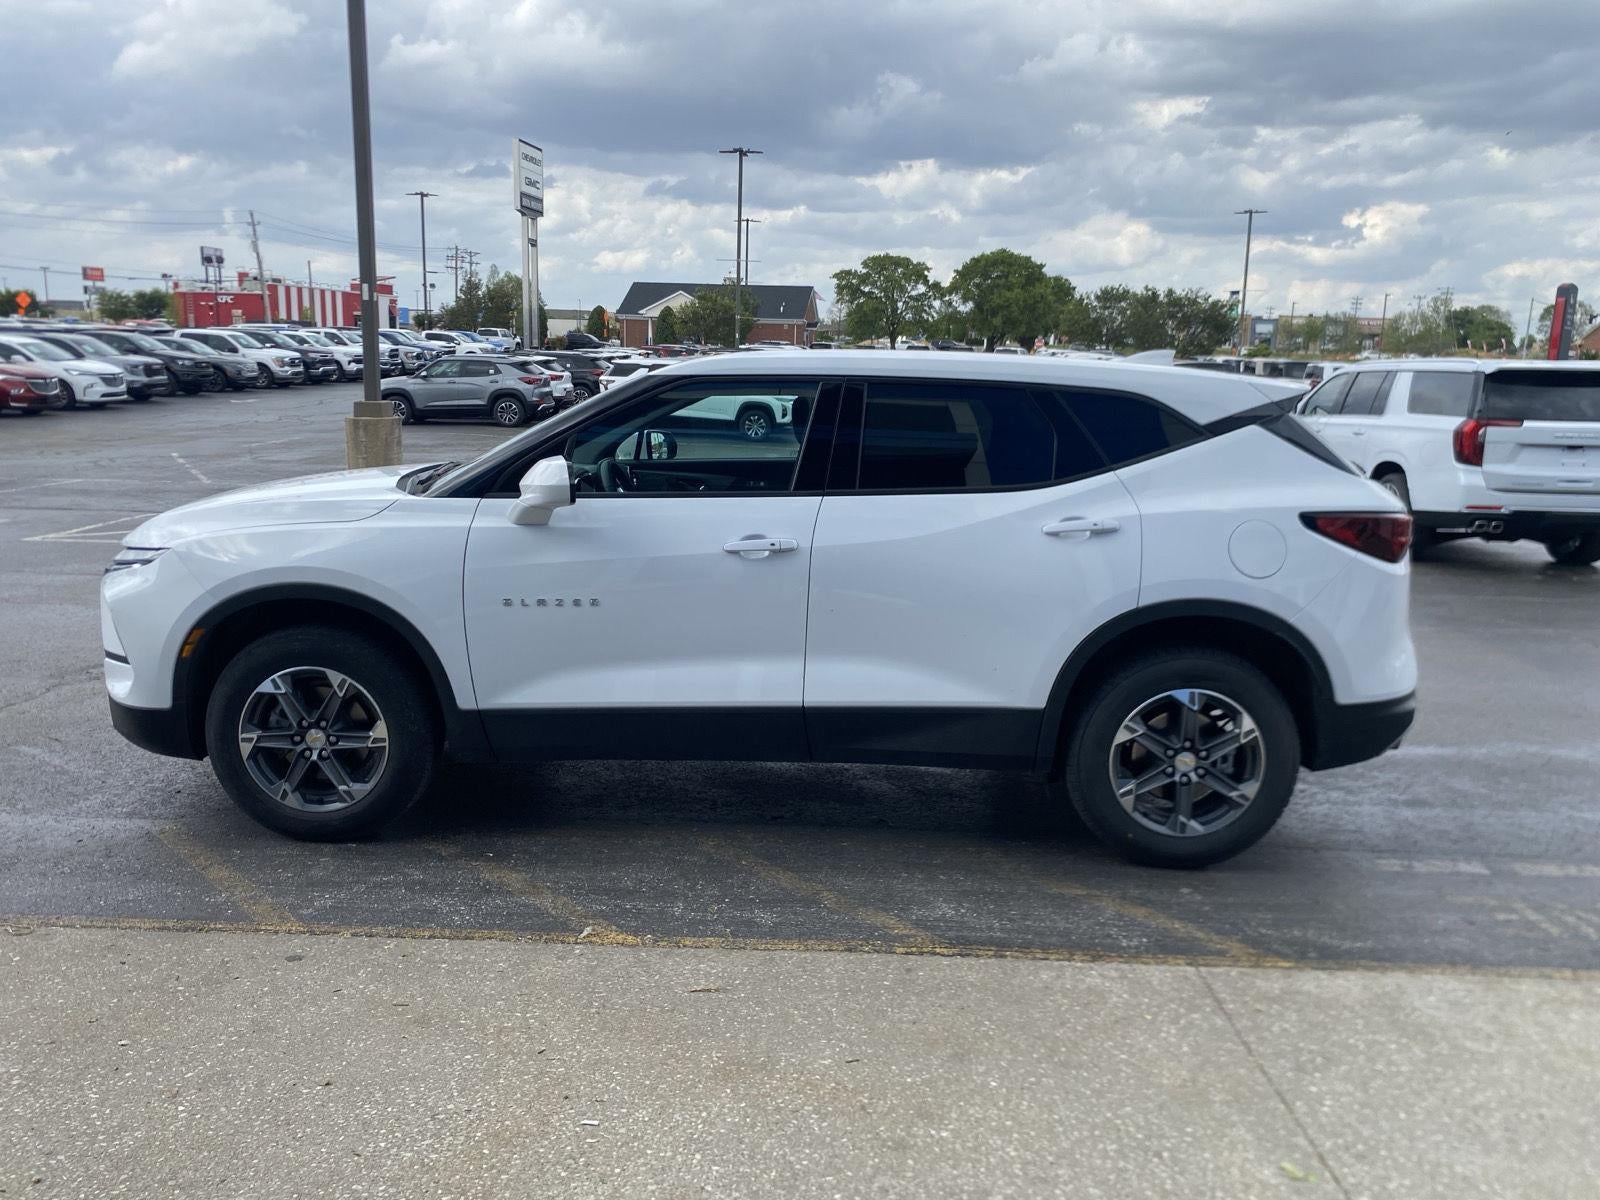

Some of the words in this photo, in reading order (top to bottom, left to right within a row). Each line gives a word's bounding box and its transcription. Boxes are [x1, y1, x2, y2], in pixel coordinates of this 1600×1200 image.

[525, 176, 541, 190] GMC
[216, 295, 235, 303] KFC
[502, 598, 600, 607] BLAZER
